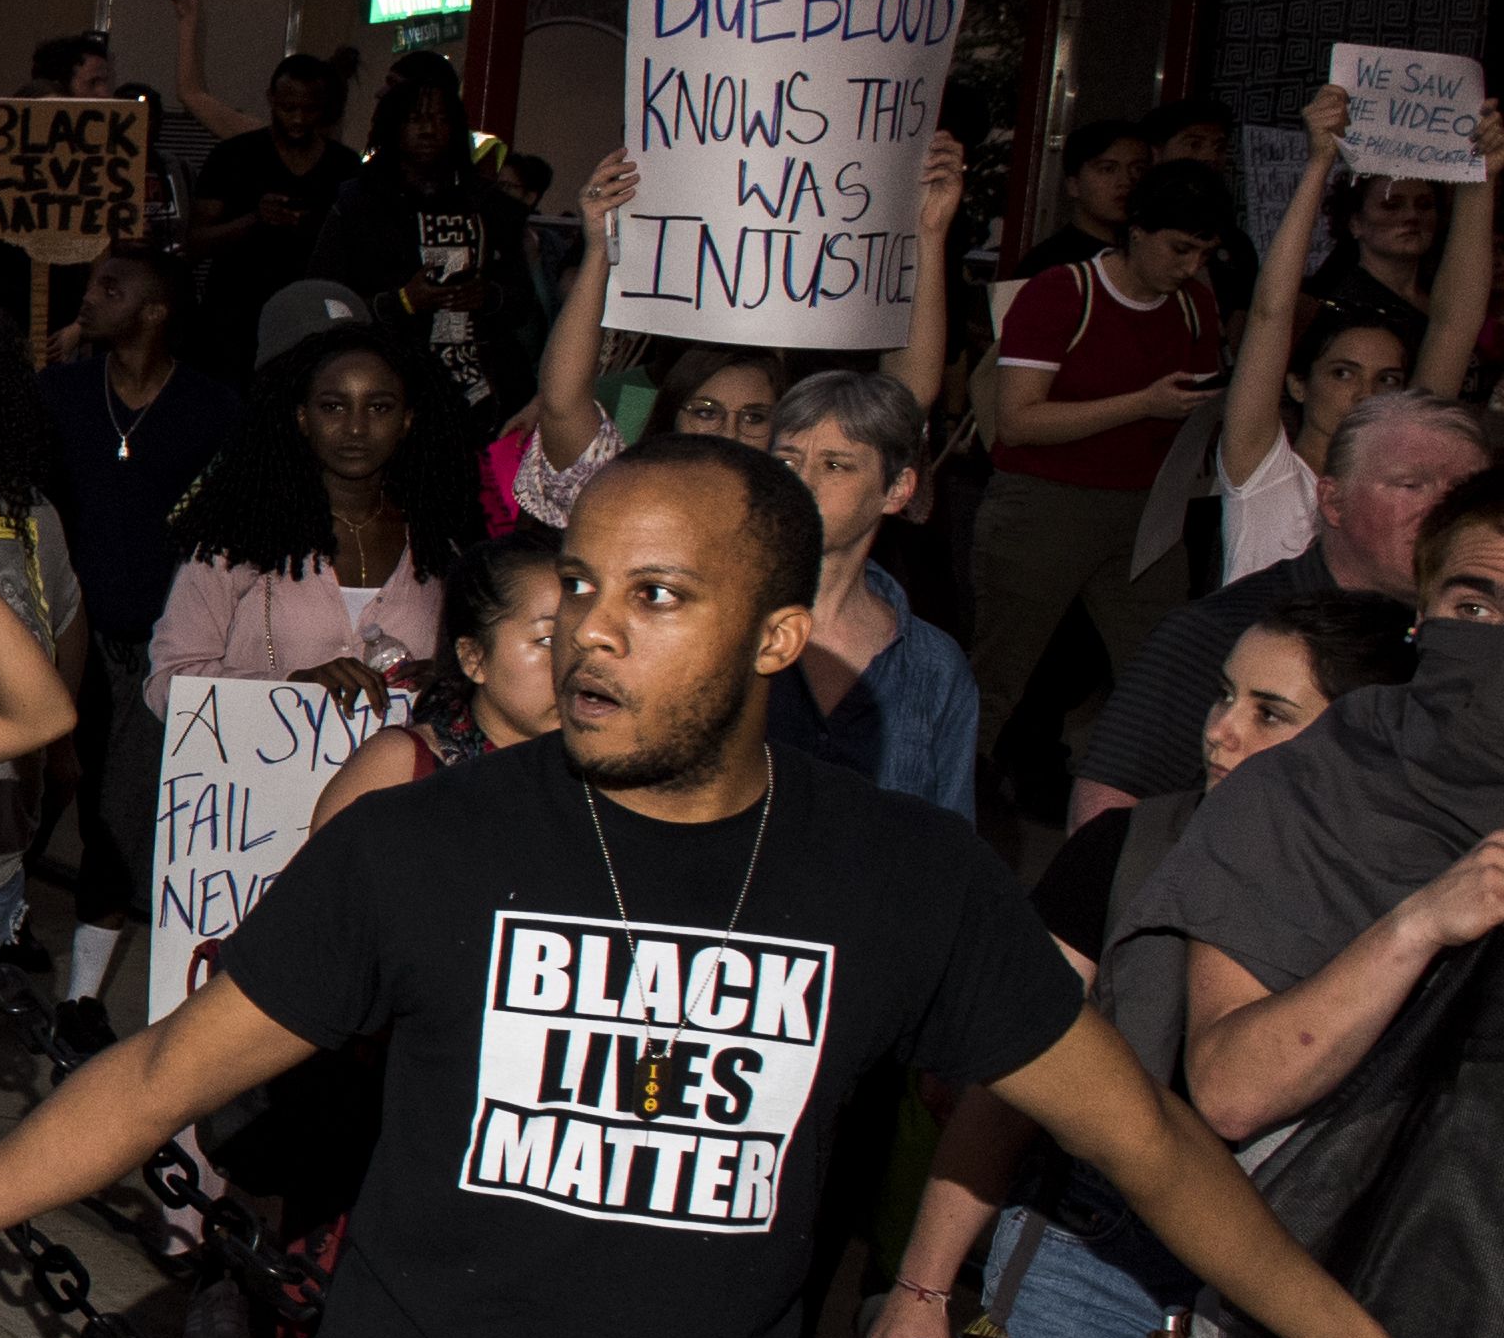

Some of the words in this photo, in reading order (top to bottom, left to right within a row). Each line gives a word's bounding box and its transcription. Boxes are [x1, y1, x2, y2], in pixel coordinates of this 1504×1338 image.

[642, 57, 829, 152] KNOWS
[846, 76, 928, 143] THIS
[1356, 56, 1393, 91] WE
[1400, 63, 1465, 100] SAW
[1388, 98, 1478, 137] VIDEO
[738, 156, 871, 223] WAS
[620, 213, 918, 312] INJUSTICE
[172, 684, 228, 764] A
[157, 771, 277, 866] FAIL
[505, 927, 819, 1041] BLACK
[478, 1107, 776, 1219] MATTER
